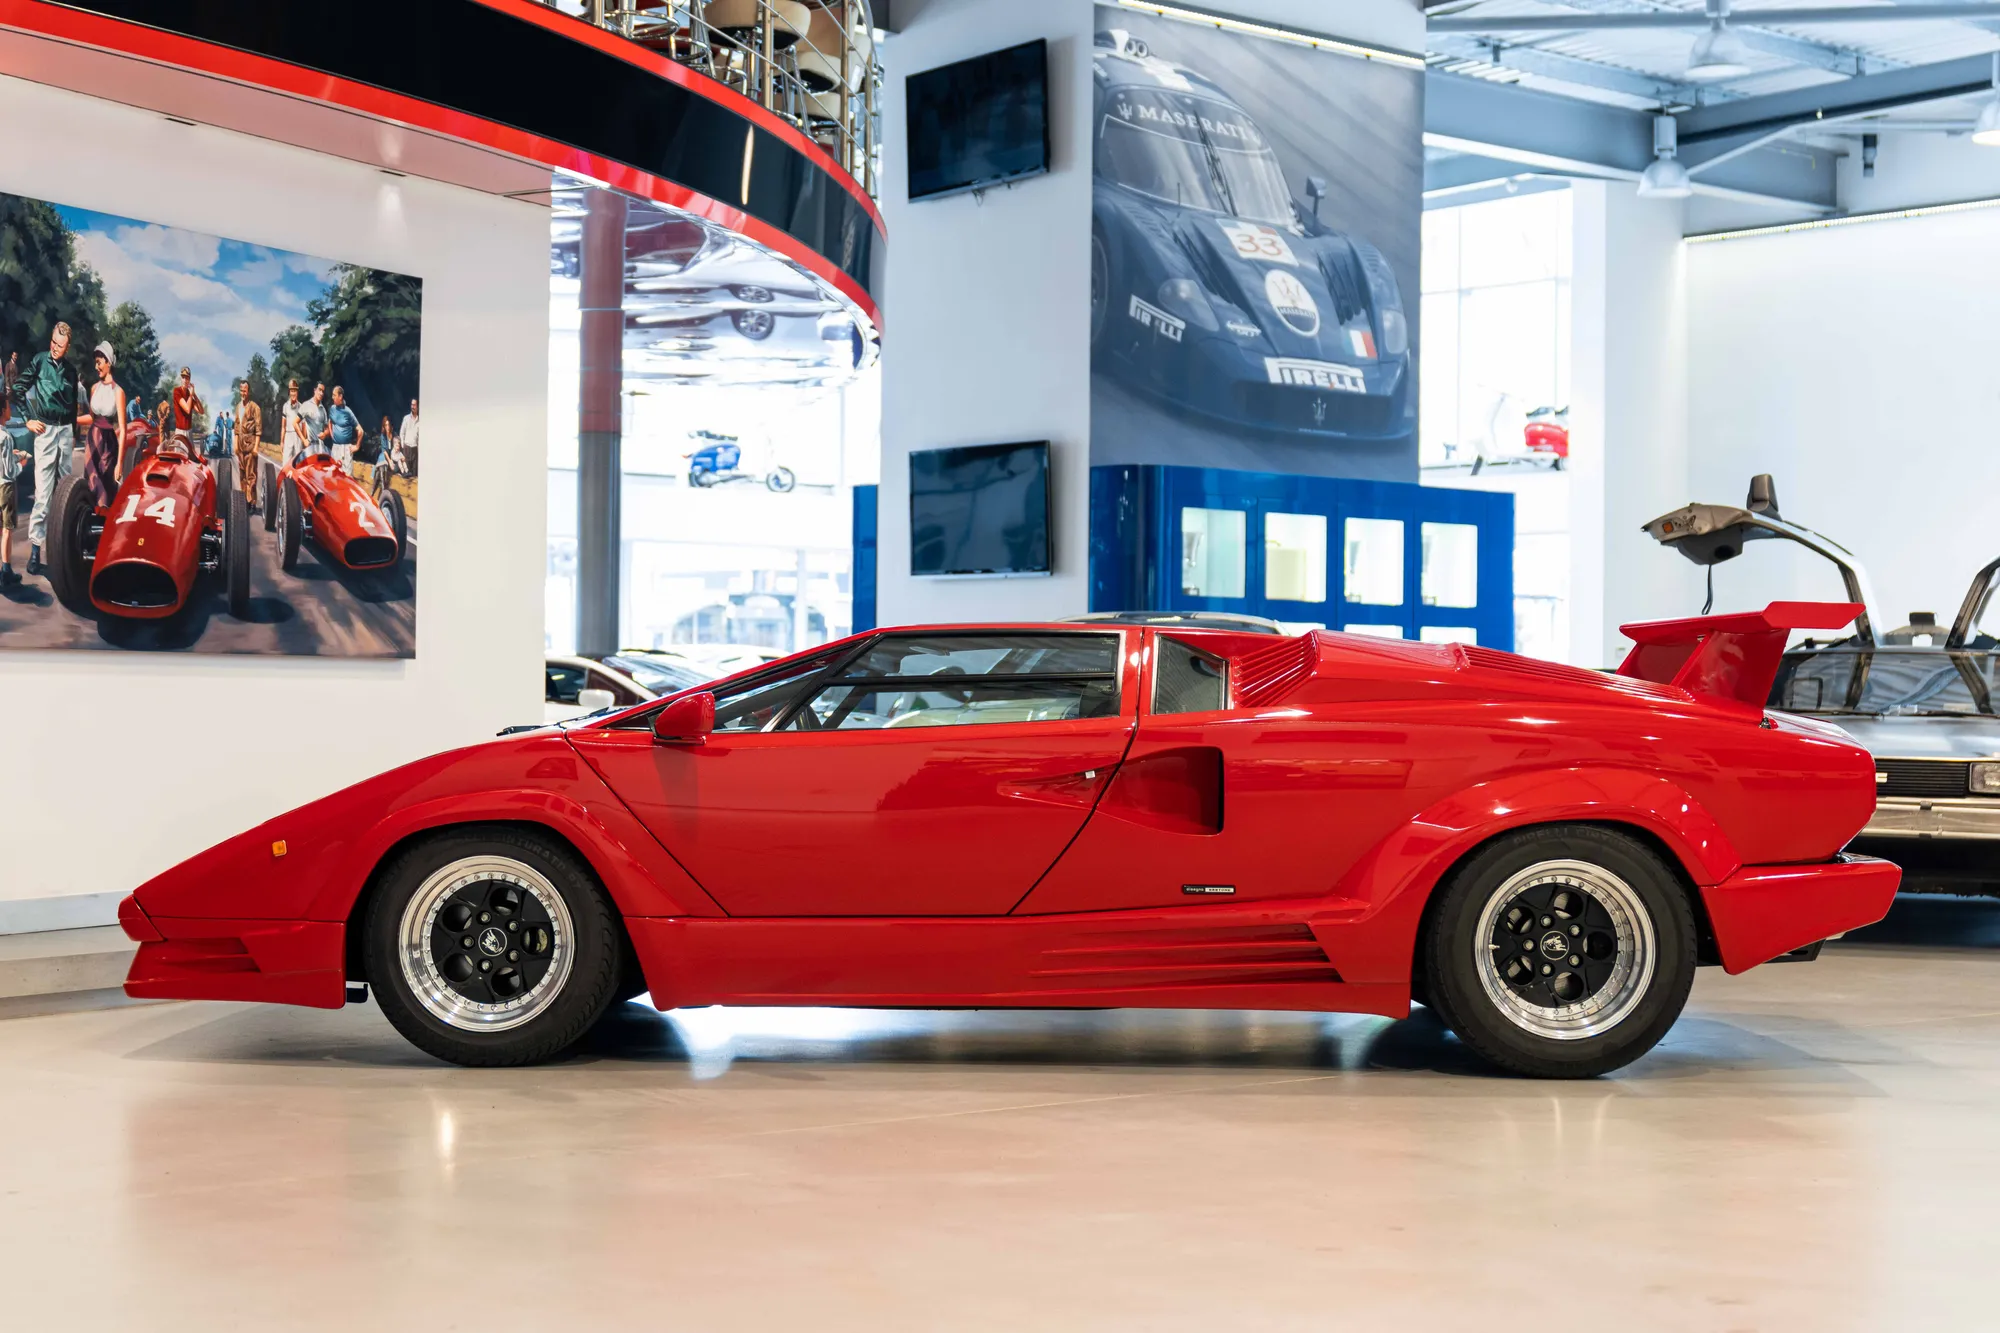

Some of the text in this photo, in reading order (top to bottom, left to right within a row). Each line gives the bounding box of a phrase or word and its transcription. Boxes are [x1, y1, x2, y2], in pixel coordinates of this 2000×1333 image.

[1137, 104, 1249, 141] MASERATI
[1236, 233, 1283, 256] 33
[1129, 294, 1186, 343] PIRLLI
[1264, 356, 1367, 394] PIRELLI
[115, 494, 176, 528] 14
[349, 501, 375, 528] 2
